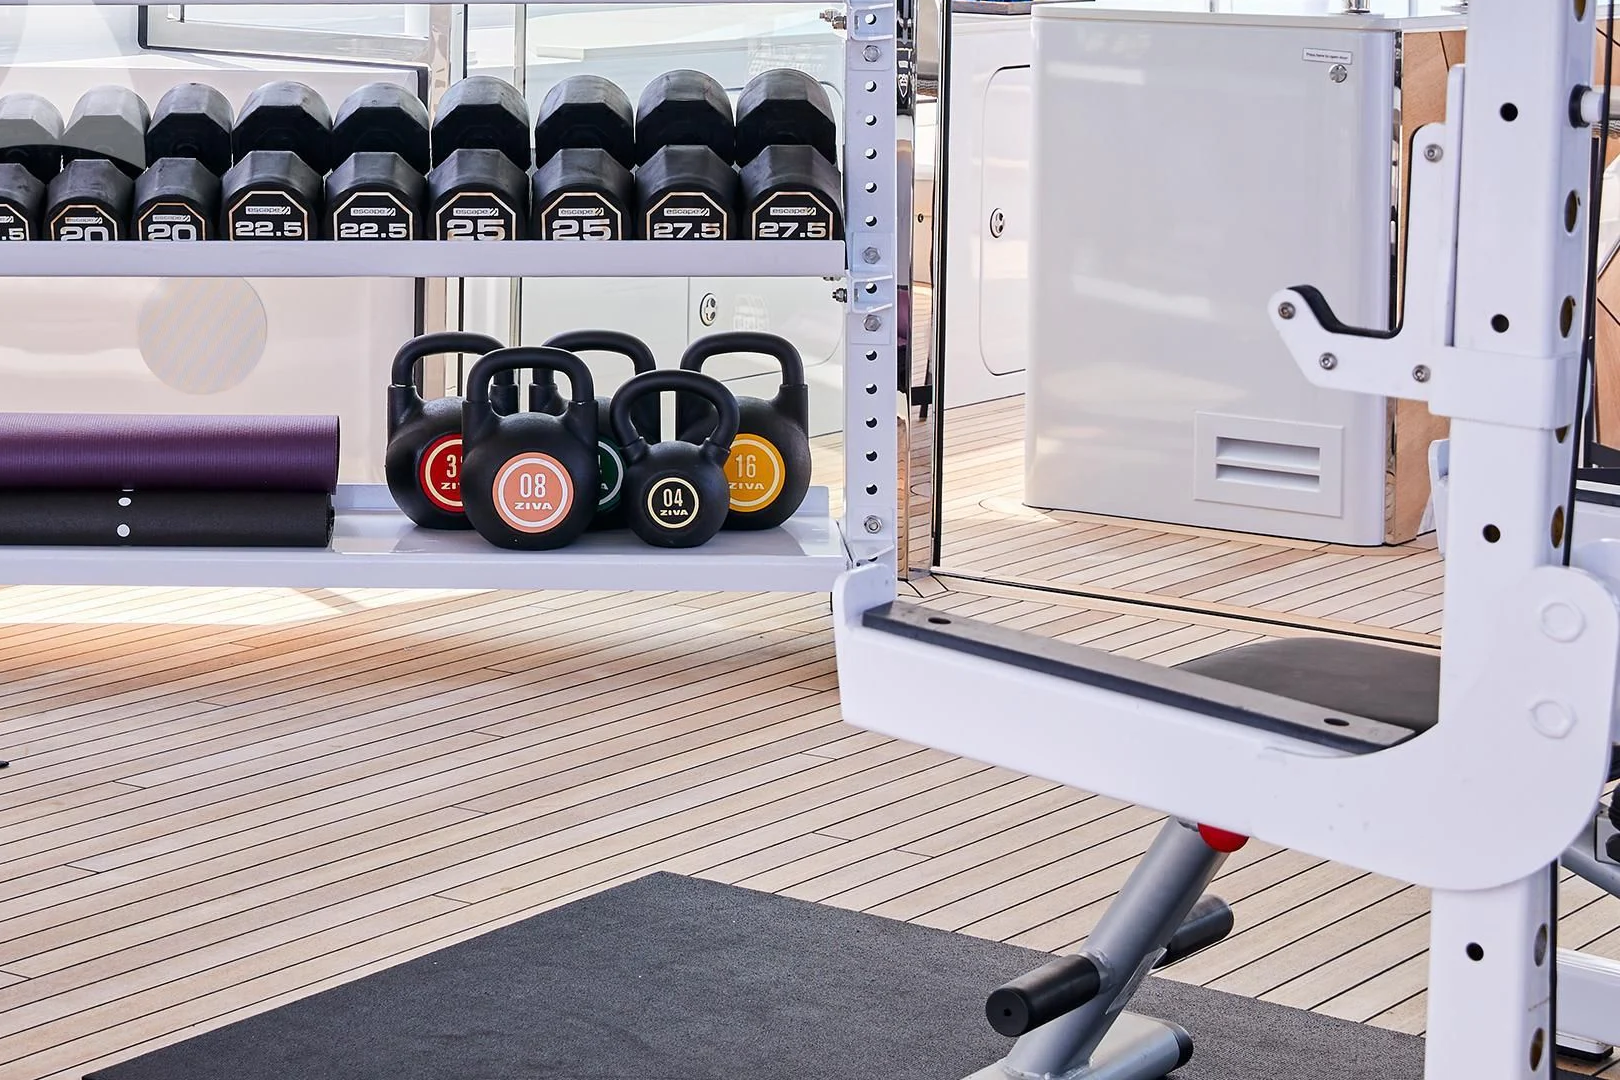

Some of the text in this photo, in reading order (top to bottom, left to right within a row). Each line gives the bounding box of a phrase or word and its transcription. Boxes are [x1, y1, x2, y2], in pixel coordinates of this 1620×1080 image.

[455, 208, 488, 216] escape
[59, 226, 109, 241] 20
[147, 223, 197, 241] 20
[235, 221, 302, 237] 22.5
[340, 223, 407, 238] 22.5
[446, 218, 506, 241] 25
[552, 218, 611, 241] 25
[653, 222, 721, 239] 27.5
[758, 222, 827, 238] 27.5
[446, 454, 463, 478] 3
[735, 454, 756, 478] 16
[441, 482, 461, 490] ZI
[519, 472, 546, 498] 08
[729, 482, 765, 490] ZIVA
[663, 488, 684, 507] 04
[514, 502, 553, 510] ZIVA
